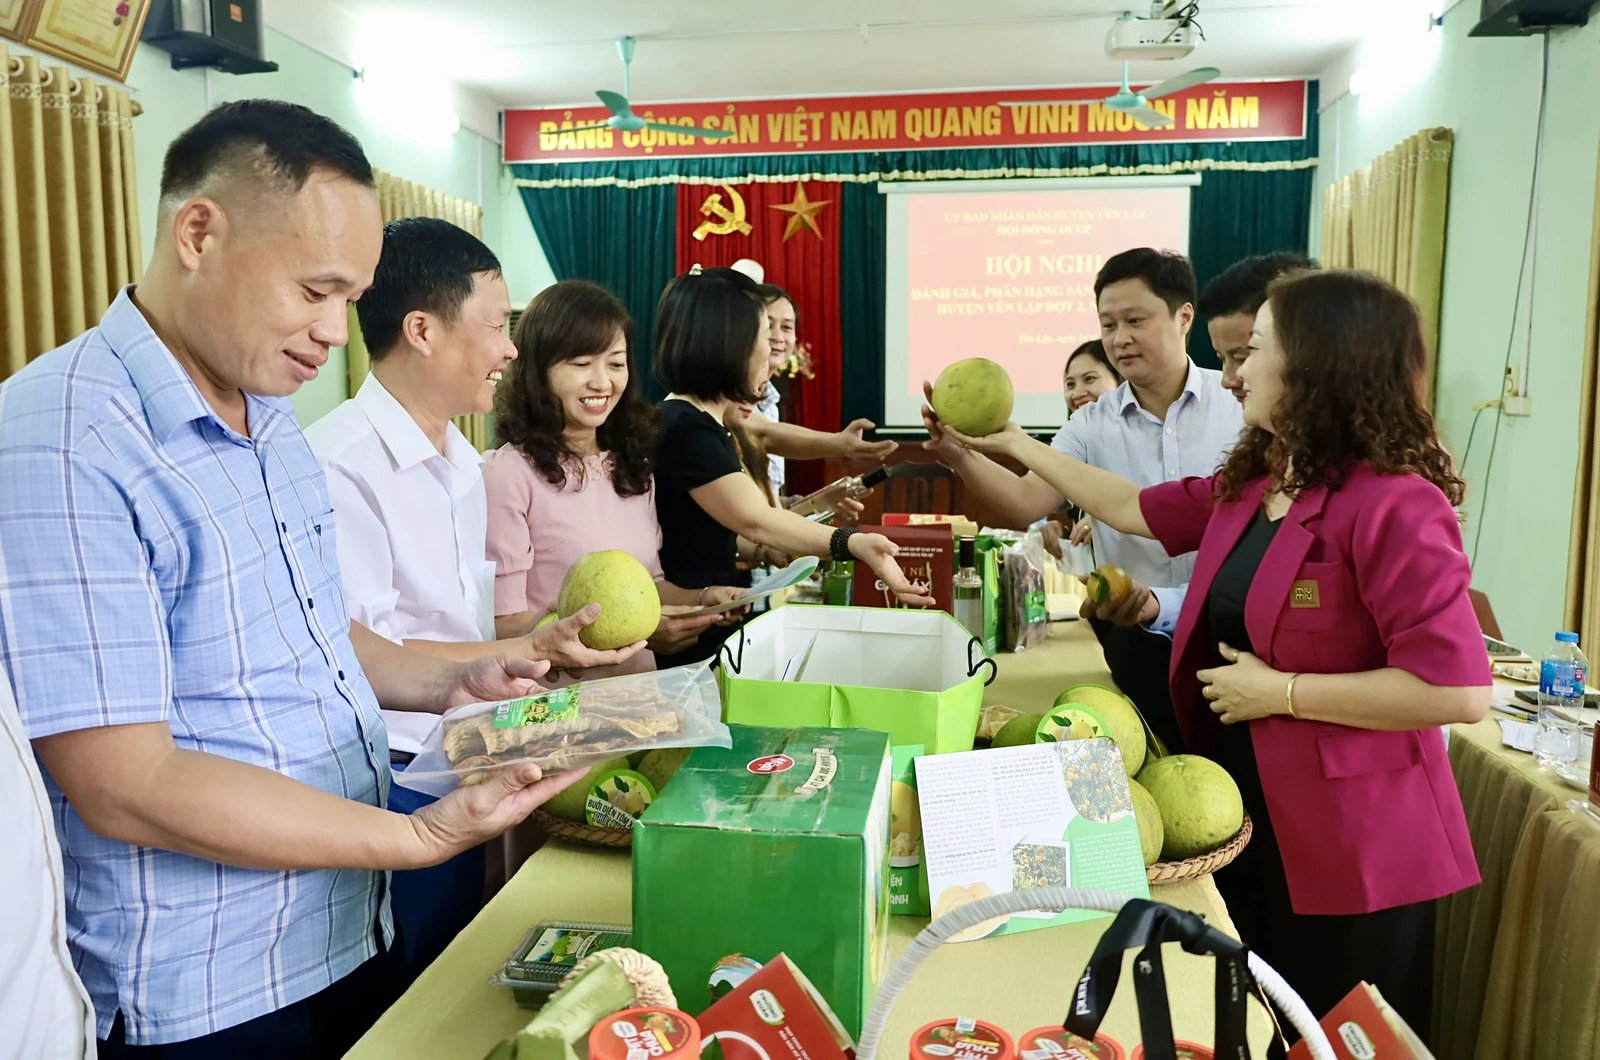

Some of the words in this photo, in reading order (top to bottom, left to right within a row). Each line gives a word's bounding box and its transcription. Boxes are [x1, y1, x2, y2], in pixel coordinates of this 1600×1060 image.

[539, 111, 614, 151] ĐẢNG
[702, 104, 760, 144] SẢN
[766, 106, 824, 148] VIỆT
[830, 110, 897, 141] NAM
[904, 104, 1002, 141] QUANG
[1011, 103, 1079, 135] VINH
[1185, 90, 1259, 130] NĂM
[963, 211, 987, 223] BAN
[985, 253, 1031, 279] HỘI
[911, 286, 950, 300] ĐÁNH
[984, 284, 1021, 299] PHÂN
[1024, 284, 1063, 300] HẠNG
[937, 301, 984, 316] HUYỆN
[987, 299, 1015, 314] YÊN
[1018, 301, 1043, 316] LẬP
[1046, 300, 1074, 314] ĐỢT
[910, 566, 932, 576] NẾ
[587, 799, 603, 811] BƯỞI
[602, 802, 617, 817] DIỄN
[616, 812, 630, 827] TÔM
[955, 1040, 999, 1055] CHUA
